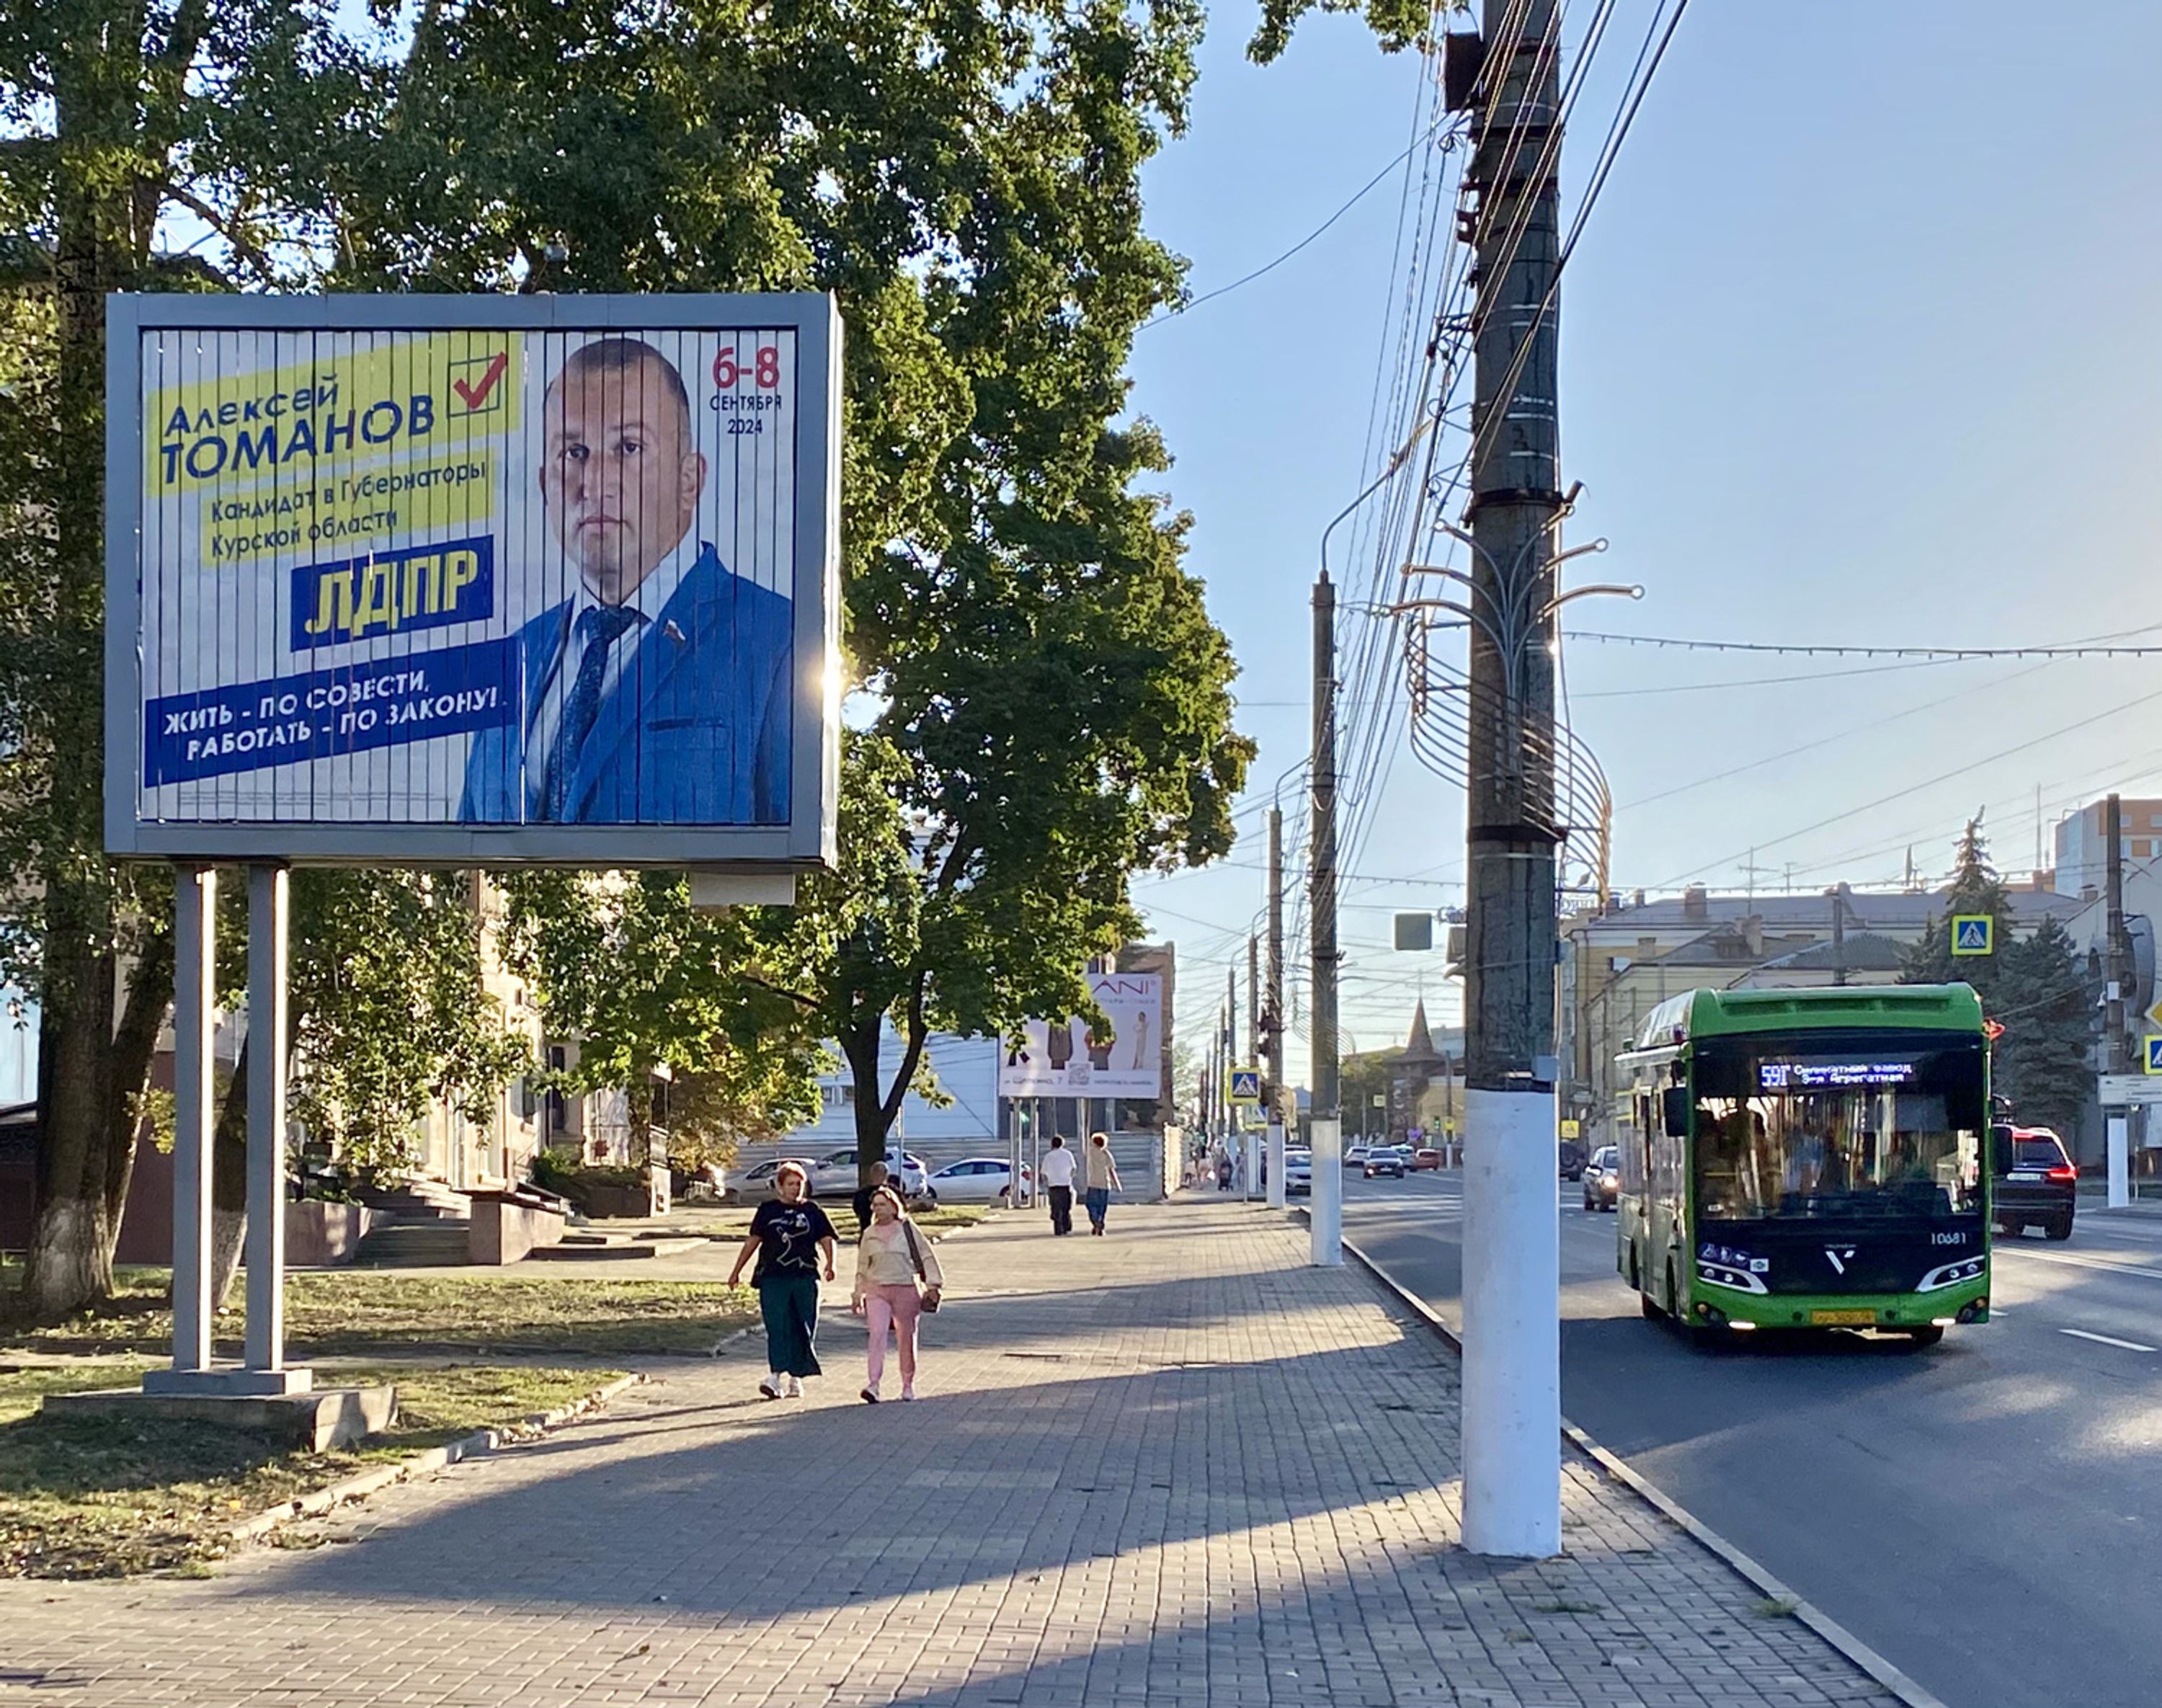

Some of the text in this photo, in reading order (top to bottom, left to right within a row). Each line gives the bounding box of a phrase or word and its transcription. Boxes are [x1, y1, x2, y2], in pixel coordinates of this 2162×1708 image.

[165, 373, 339, 437] Алексей
[709, 395, 783, 411] СЕНТЯБРЯ
[727, 419, 763, 435] 2024
[161, 394, 436, 484] ТОМАНОВ
[211, 461, 486, 524] Кандидат в Губернаторы
[211, 508, 398, 559] Курской области
[304, 550, 479, 636] ЛДПР
[163, 706, 233, 736] ЖИТЬ
[259, 693, 298, 719] ПО
[186, 721, 311, 761] РАБОТАТЬ
[340, 709, 378, 735] ПО
[385, 686, 499, 725] ЗАКОНУ!
